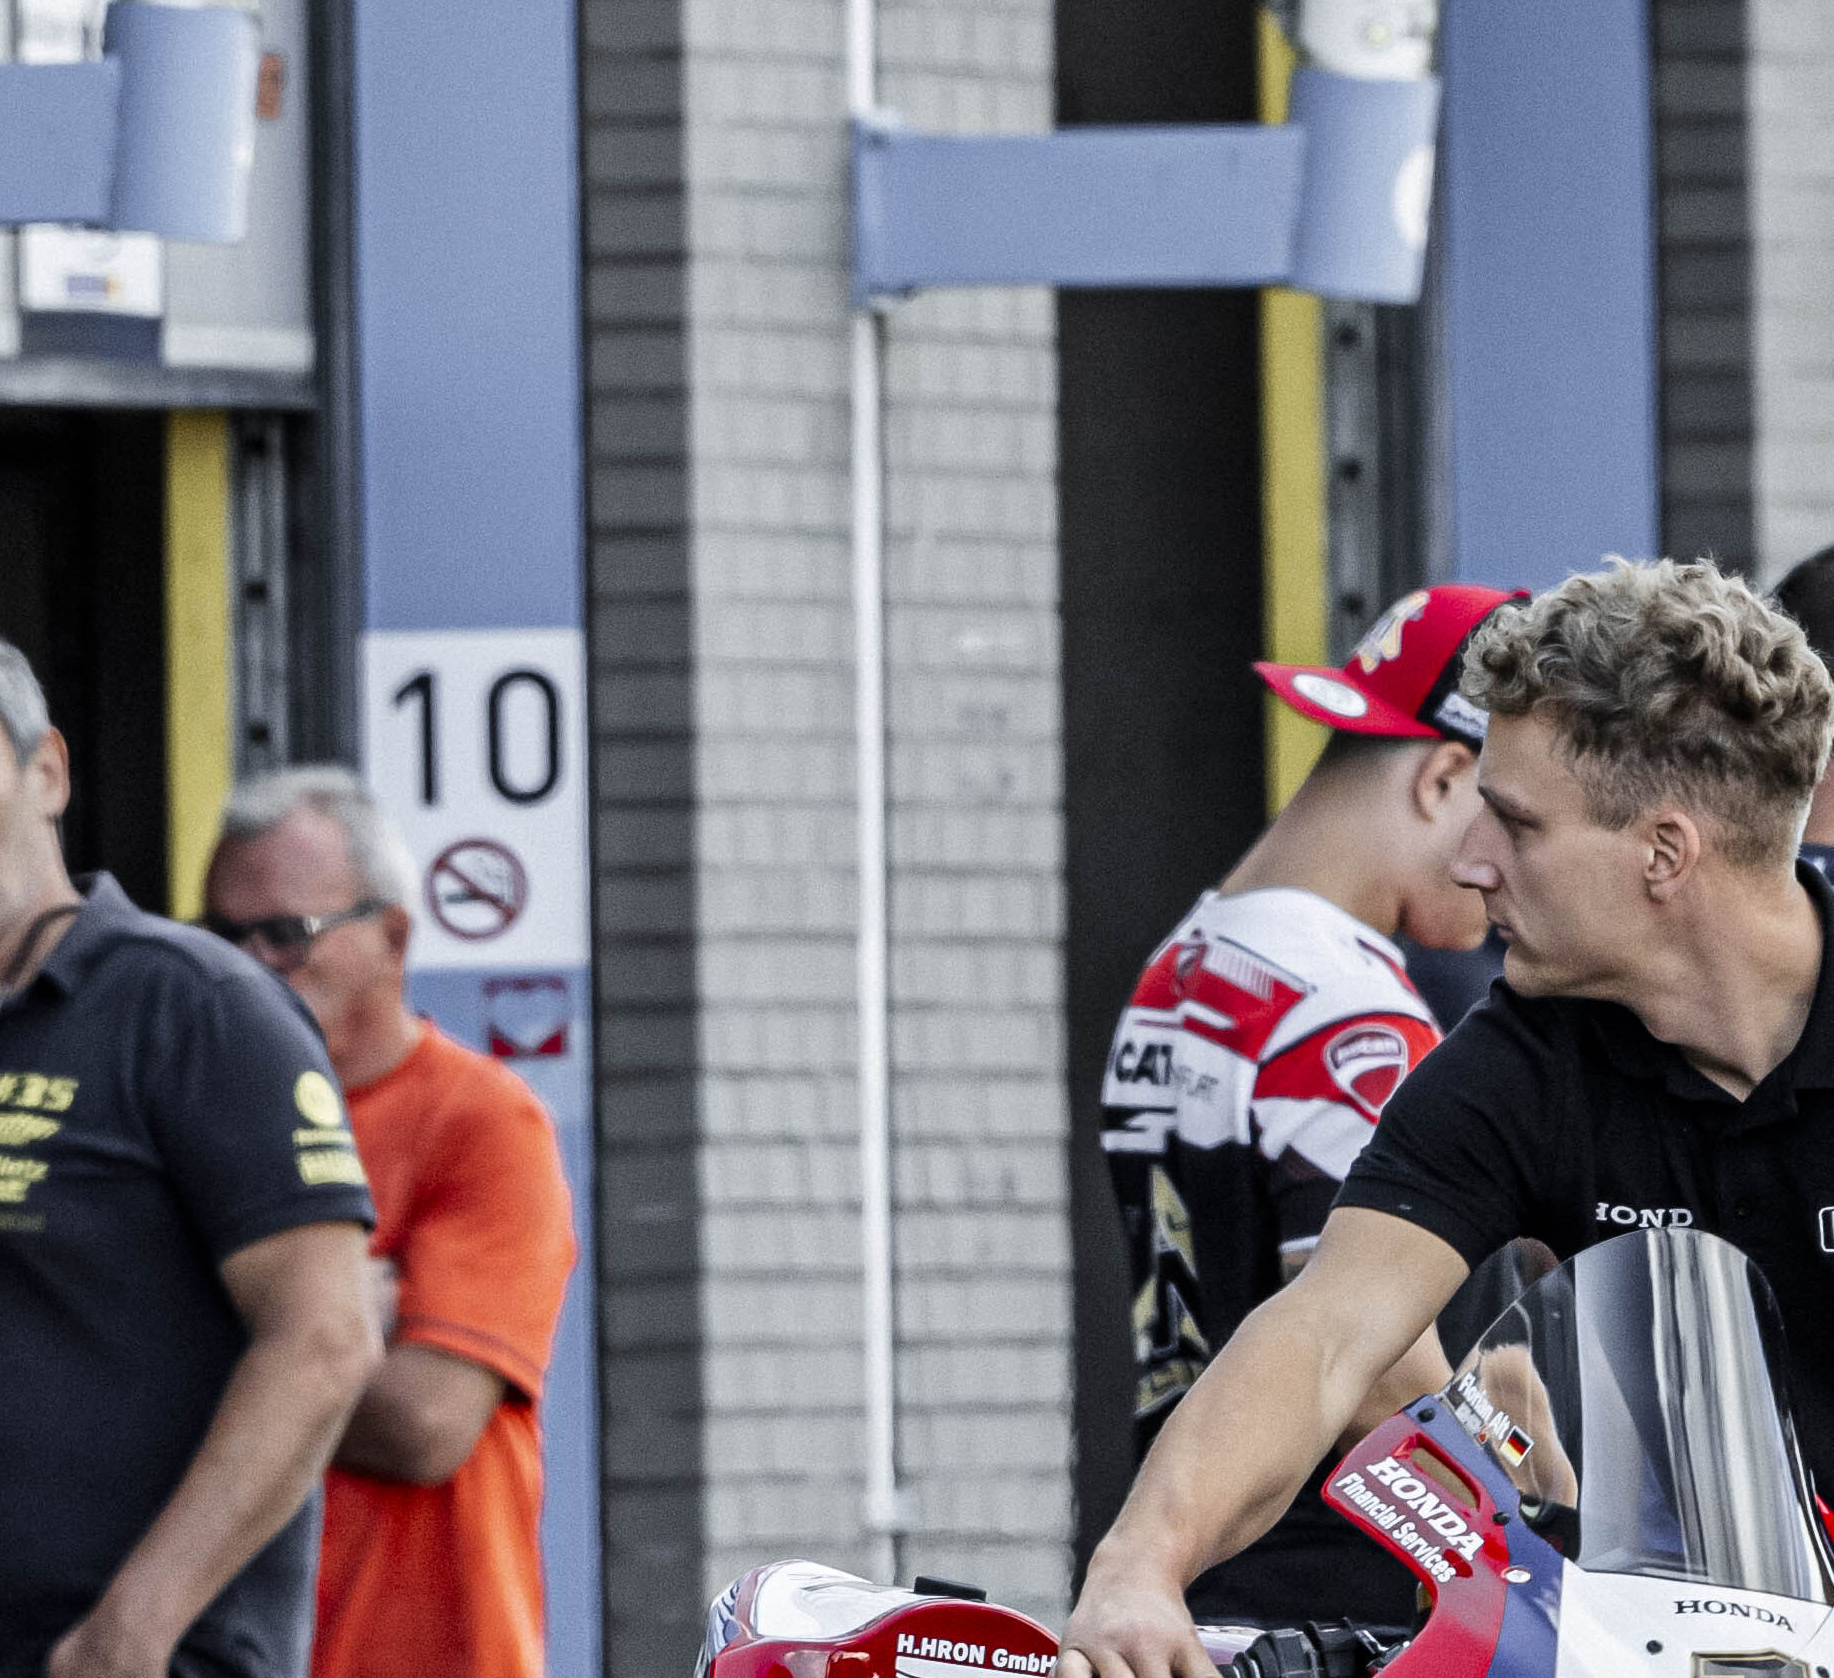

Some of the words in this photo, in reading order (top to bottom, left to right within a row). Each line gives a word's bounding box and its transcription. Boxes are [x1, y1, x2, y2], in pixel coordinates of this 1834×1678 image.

[391, 667, 561, 806] 10
[1336, 1472, 1407, 1530] Financial
[1392, 1521, 1457, 1583] Services
[1366, 1456, 1485, 1561] HONDA
[897, 1633, 986, 1665] H.HRON
[991, 1648, 1057, 1674] GmbH
[1674, 1600, 1796, 1634] HONDA
